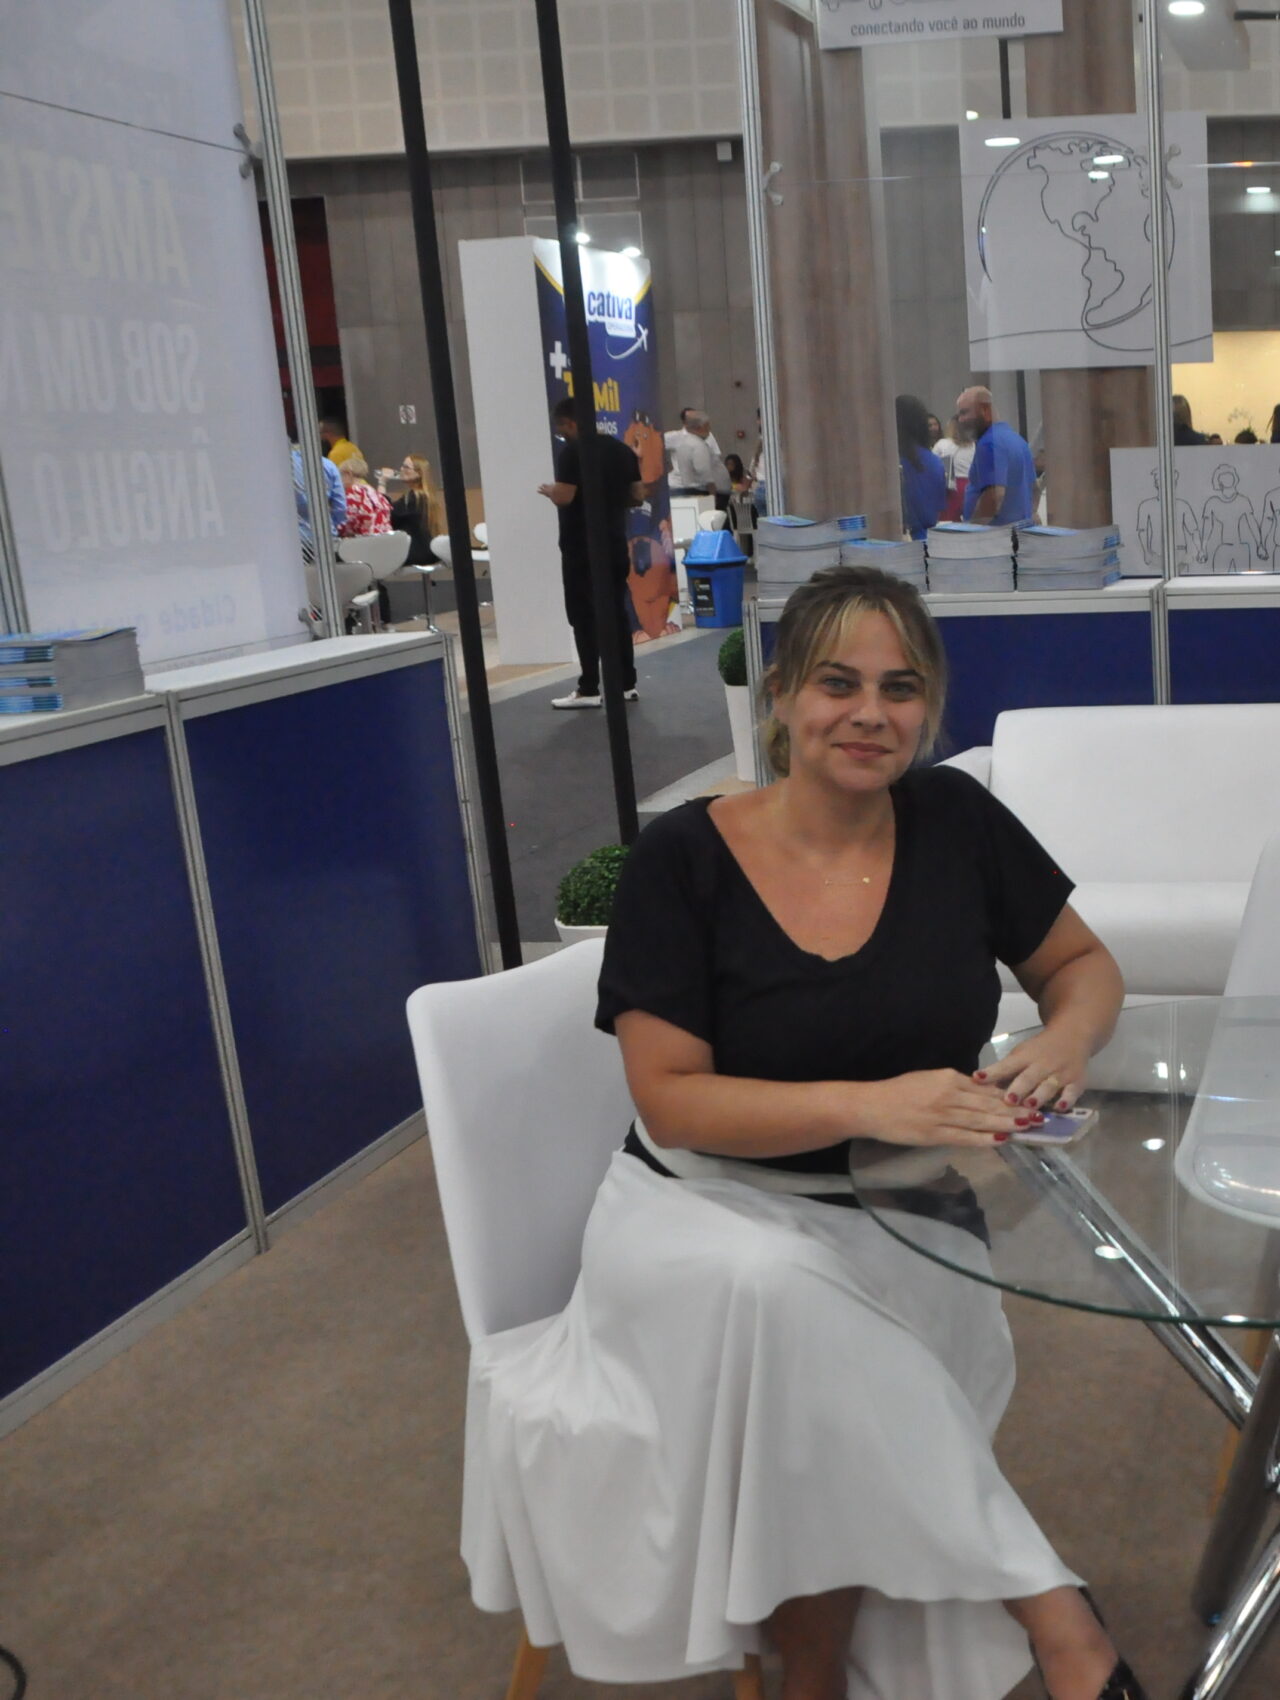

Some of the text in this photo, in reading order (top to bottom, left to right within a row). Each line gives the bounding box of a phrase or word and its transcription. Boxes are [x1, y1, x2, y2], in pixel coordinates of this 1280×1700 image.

[850, 12, 1026, 36] conectando você ao mundo
